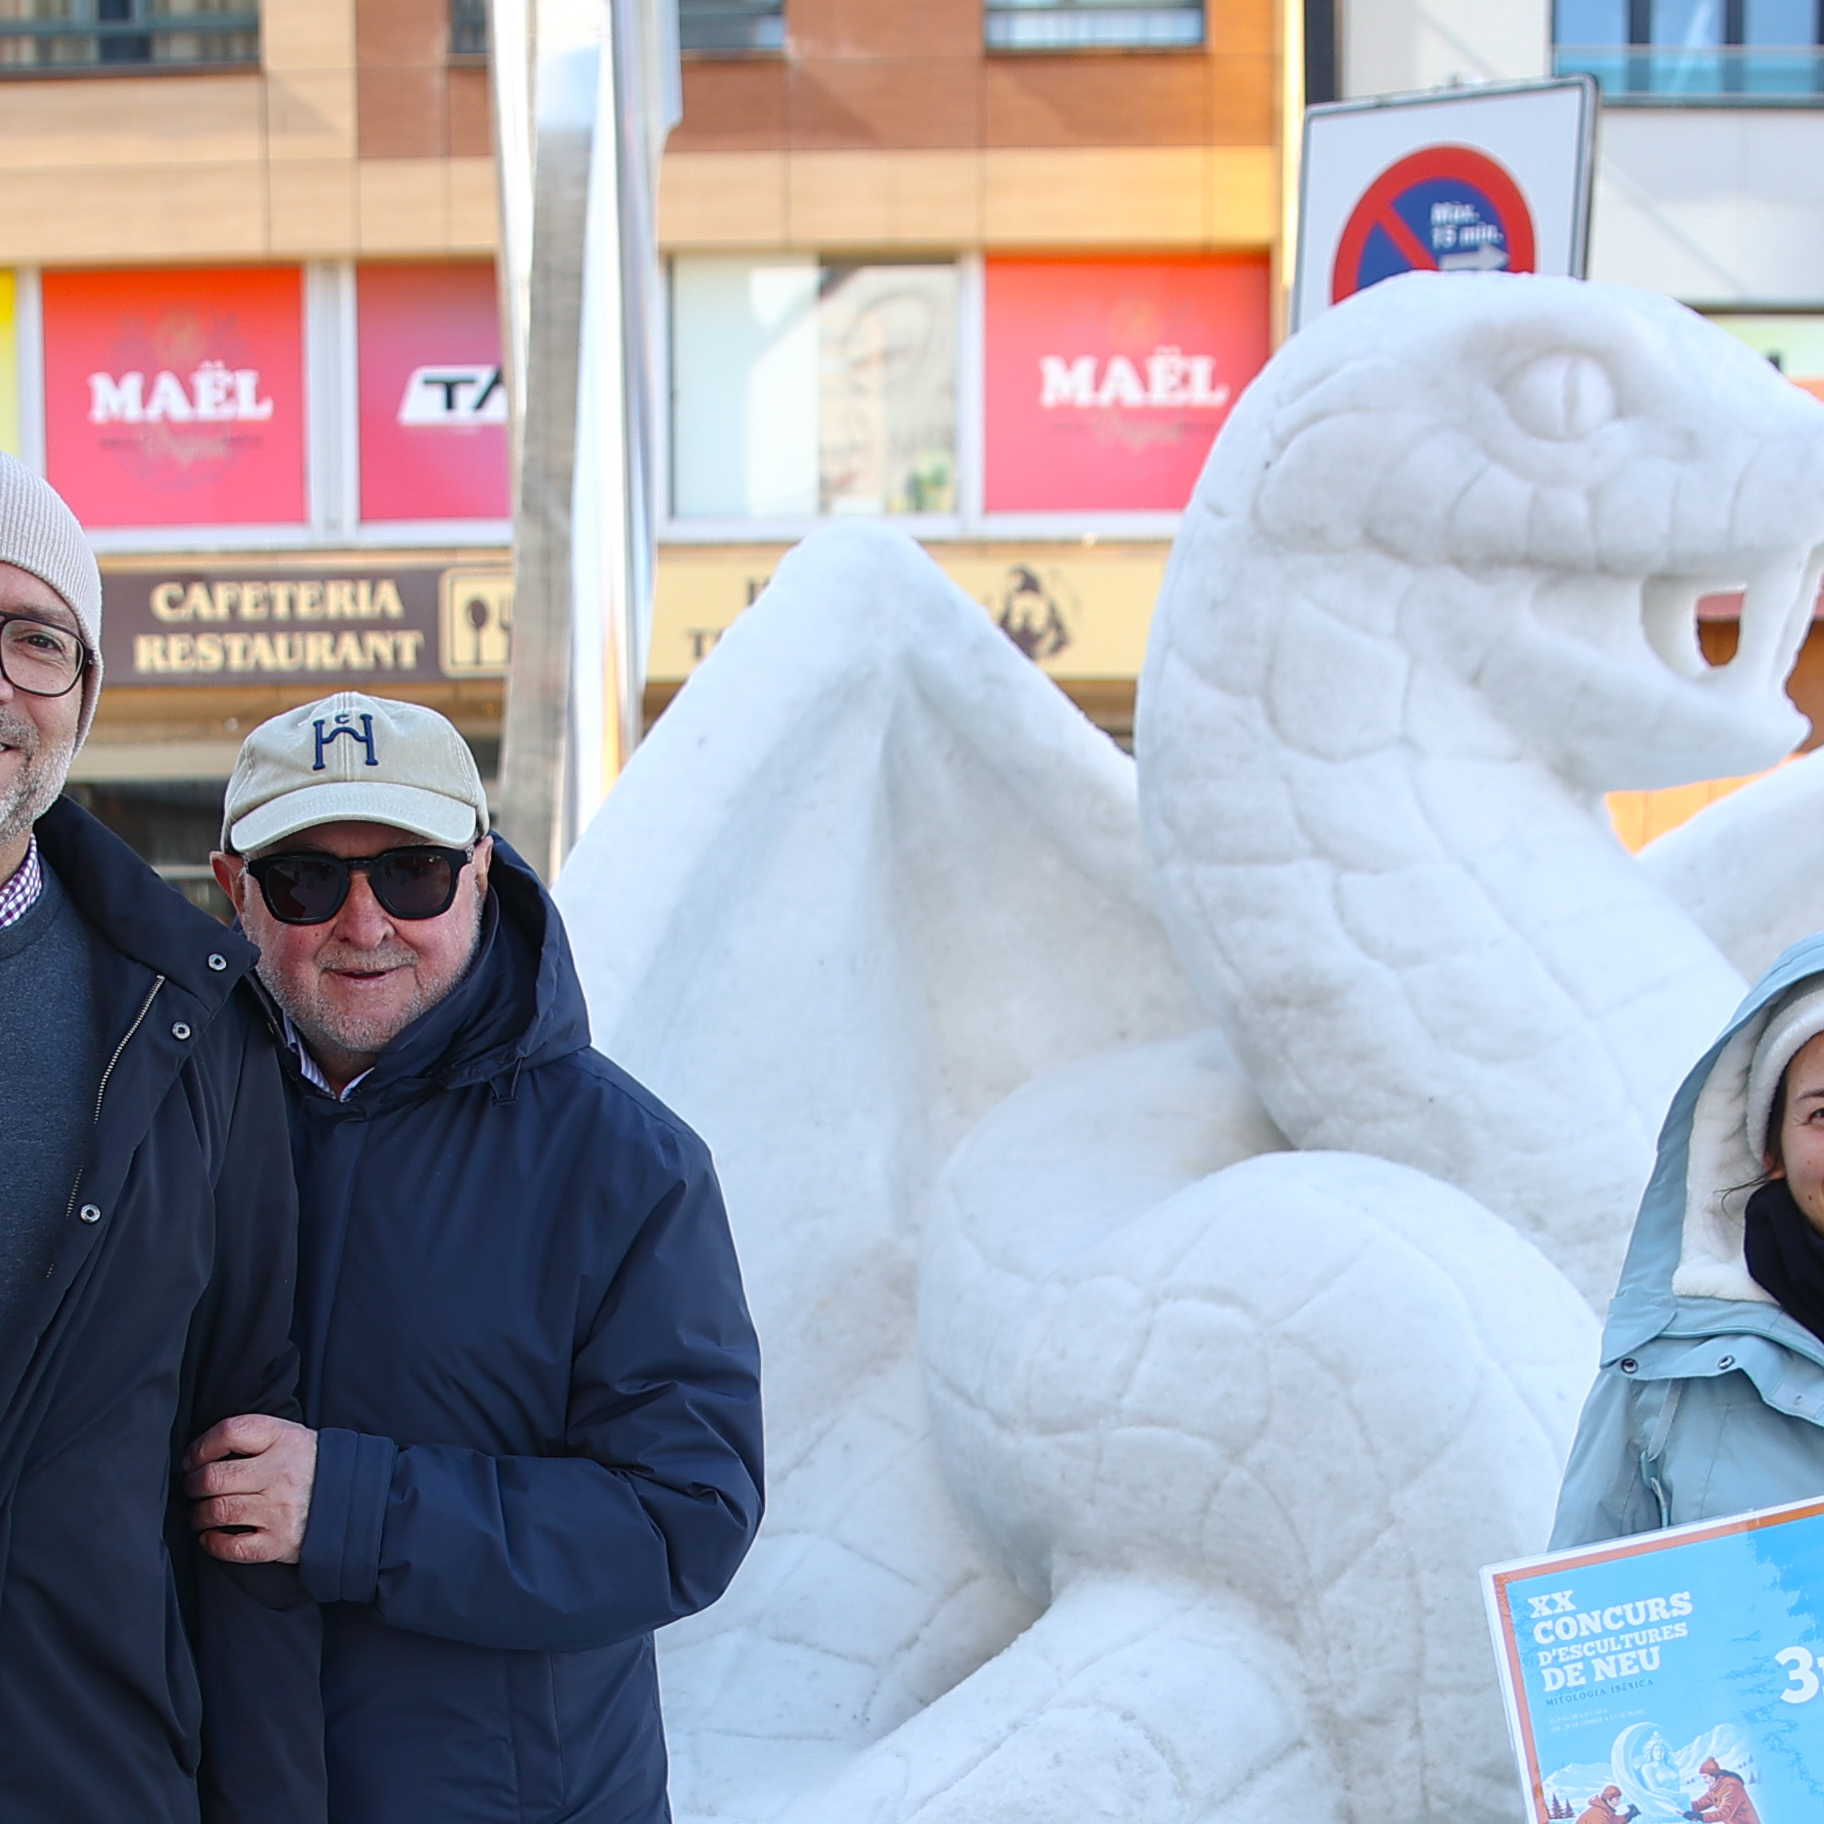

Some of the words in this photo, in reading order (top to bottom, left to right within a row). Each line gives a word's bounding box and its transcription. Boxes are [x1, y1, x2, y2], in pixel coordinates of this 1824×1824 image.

[88, 360, 274, 424] MAËL
[1038, 346, 1230, 407] MAËL
[150, 578, 406, 623] CAFETERIA
[133, 628, 426, 674] RESTAURANT
[1527, 1589, 1576, 1618] XX
[1533, 1590, 1693, 1645] CONCURS
[1537, 1622, 1688, 1666] D'ESCULTURES
[1541, 1661, 1587, 1692] DE
[1591, 1645, 1660, 1682] NEU
[1546, 1687, 1606, 1706] MITOLOGIA
